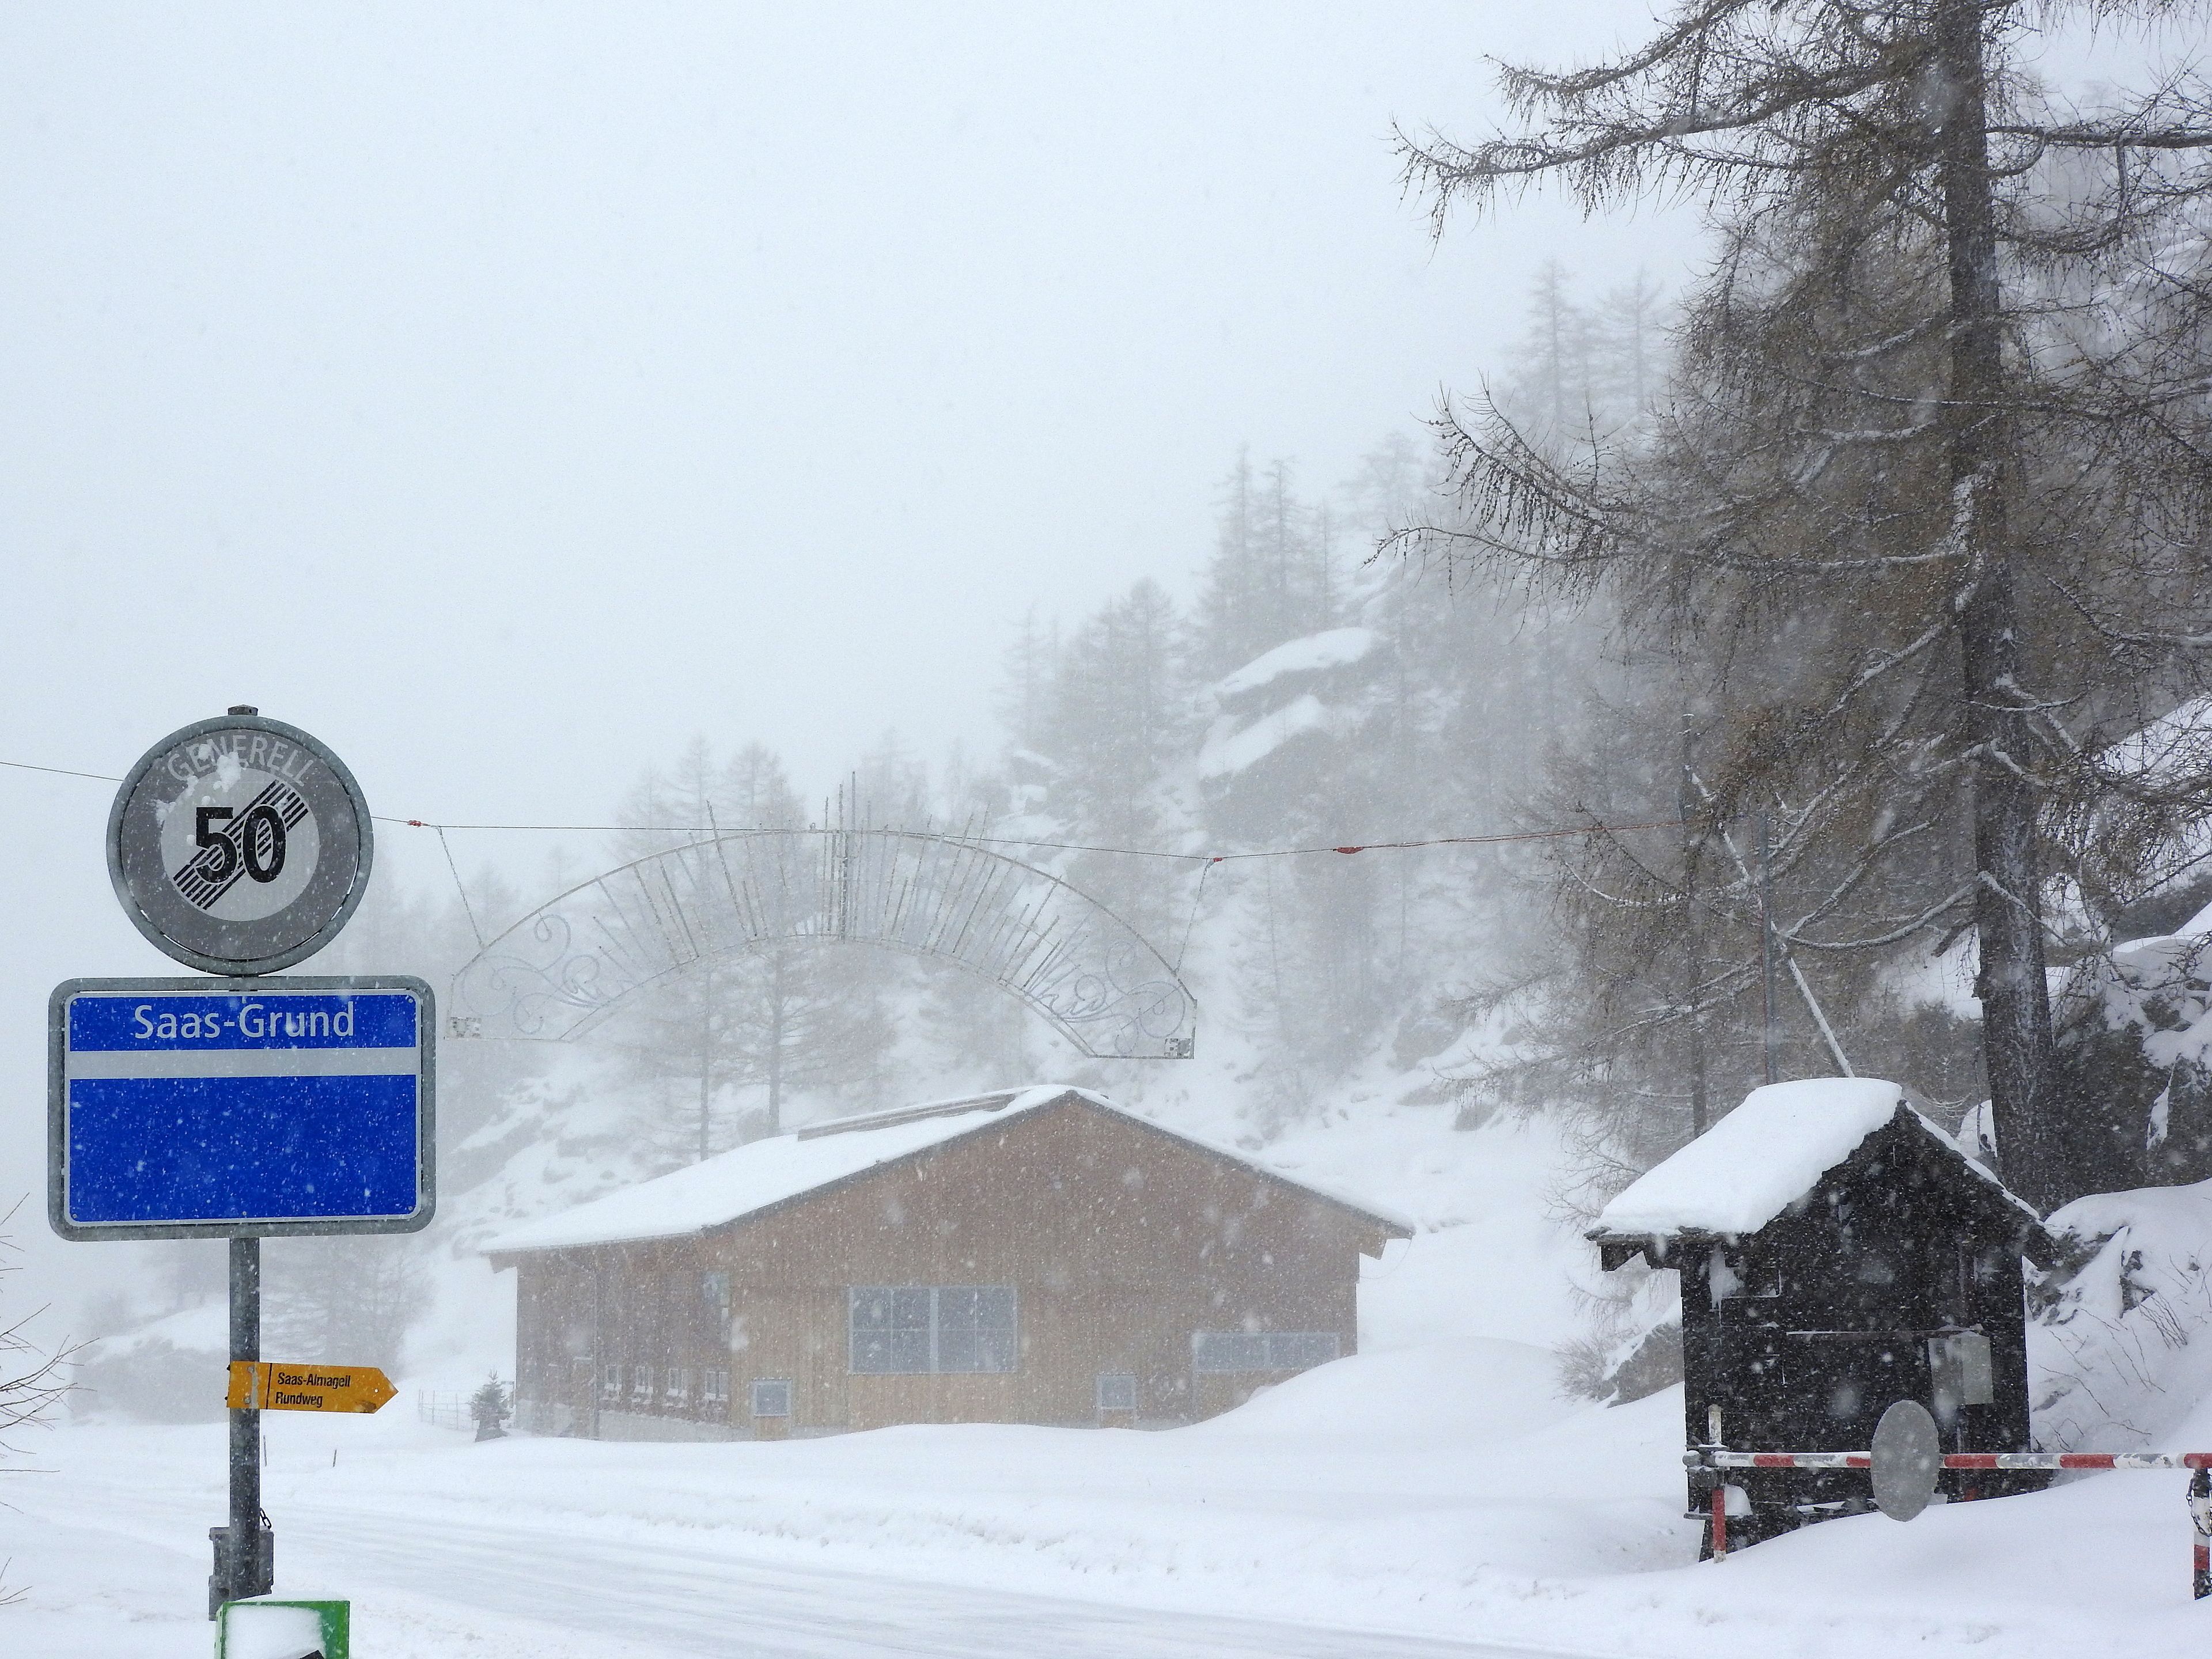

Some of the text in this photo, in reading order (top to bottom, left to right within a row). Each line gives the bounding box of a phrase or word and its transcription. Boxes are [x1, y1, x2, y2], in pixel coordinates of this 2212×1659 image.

[168, 734, 314, 787] GENERELL
[196, 806, 286, 882] 50
[134, 1001, 354, 1039] Saas-Grund
[275, 1391, 323, 1408] Rundweg
[278, 1372, 351, 1389] Saas-Almagell
